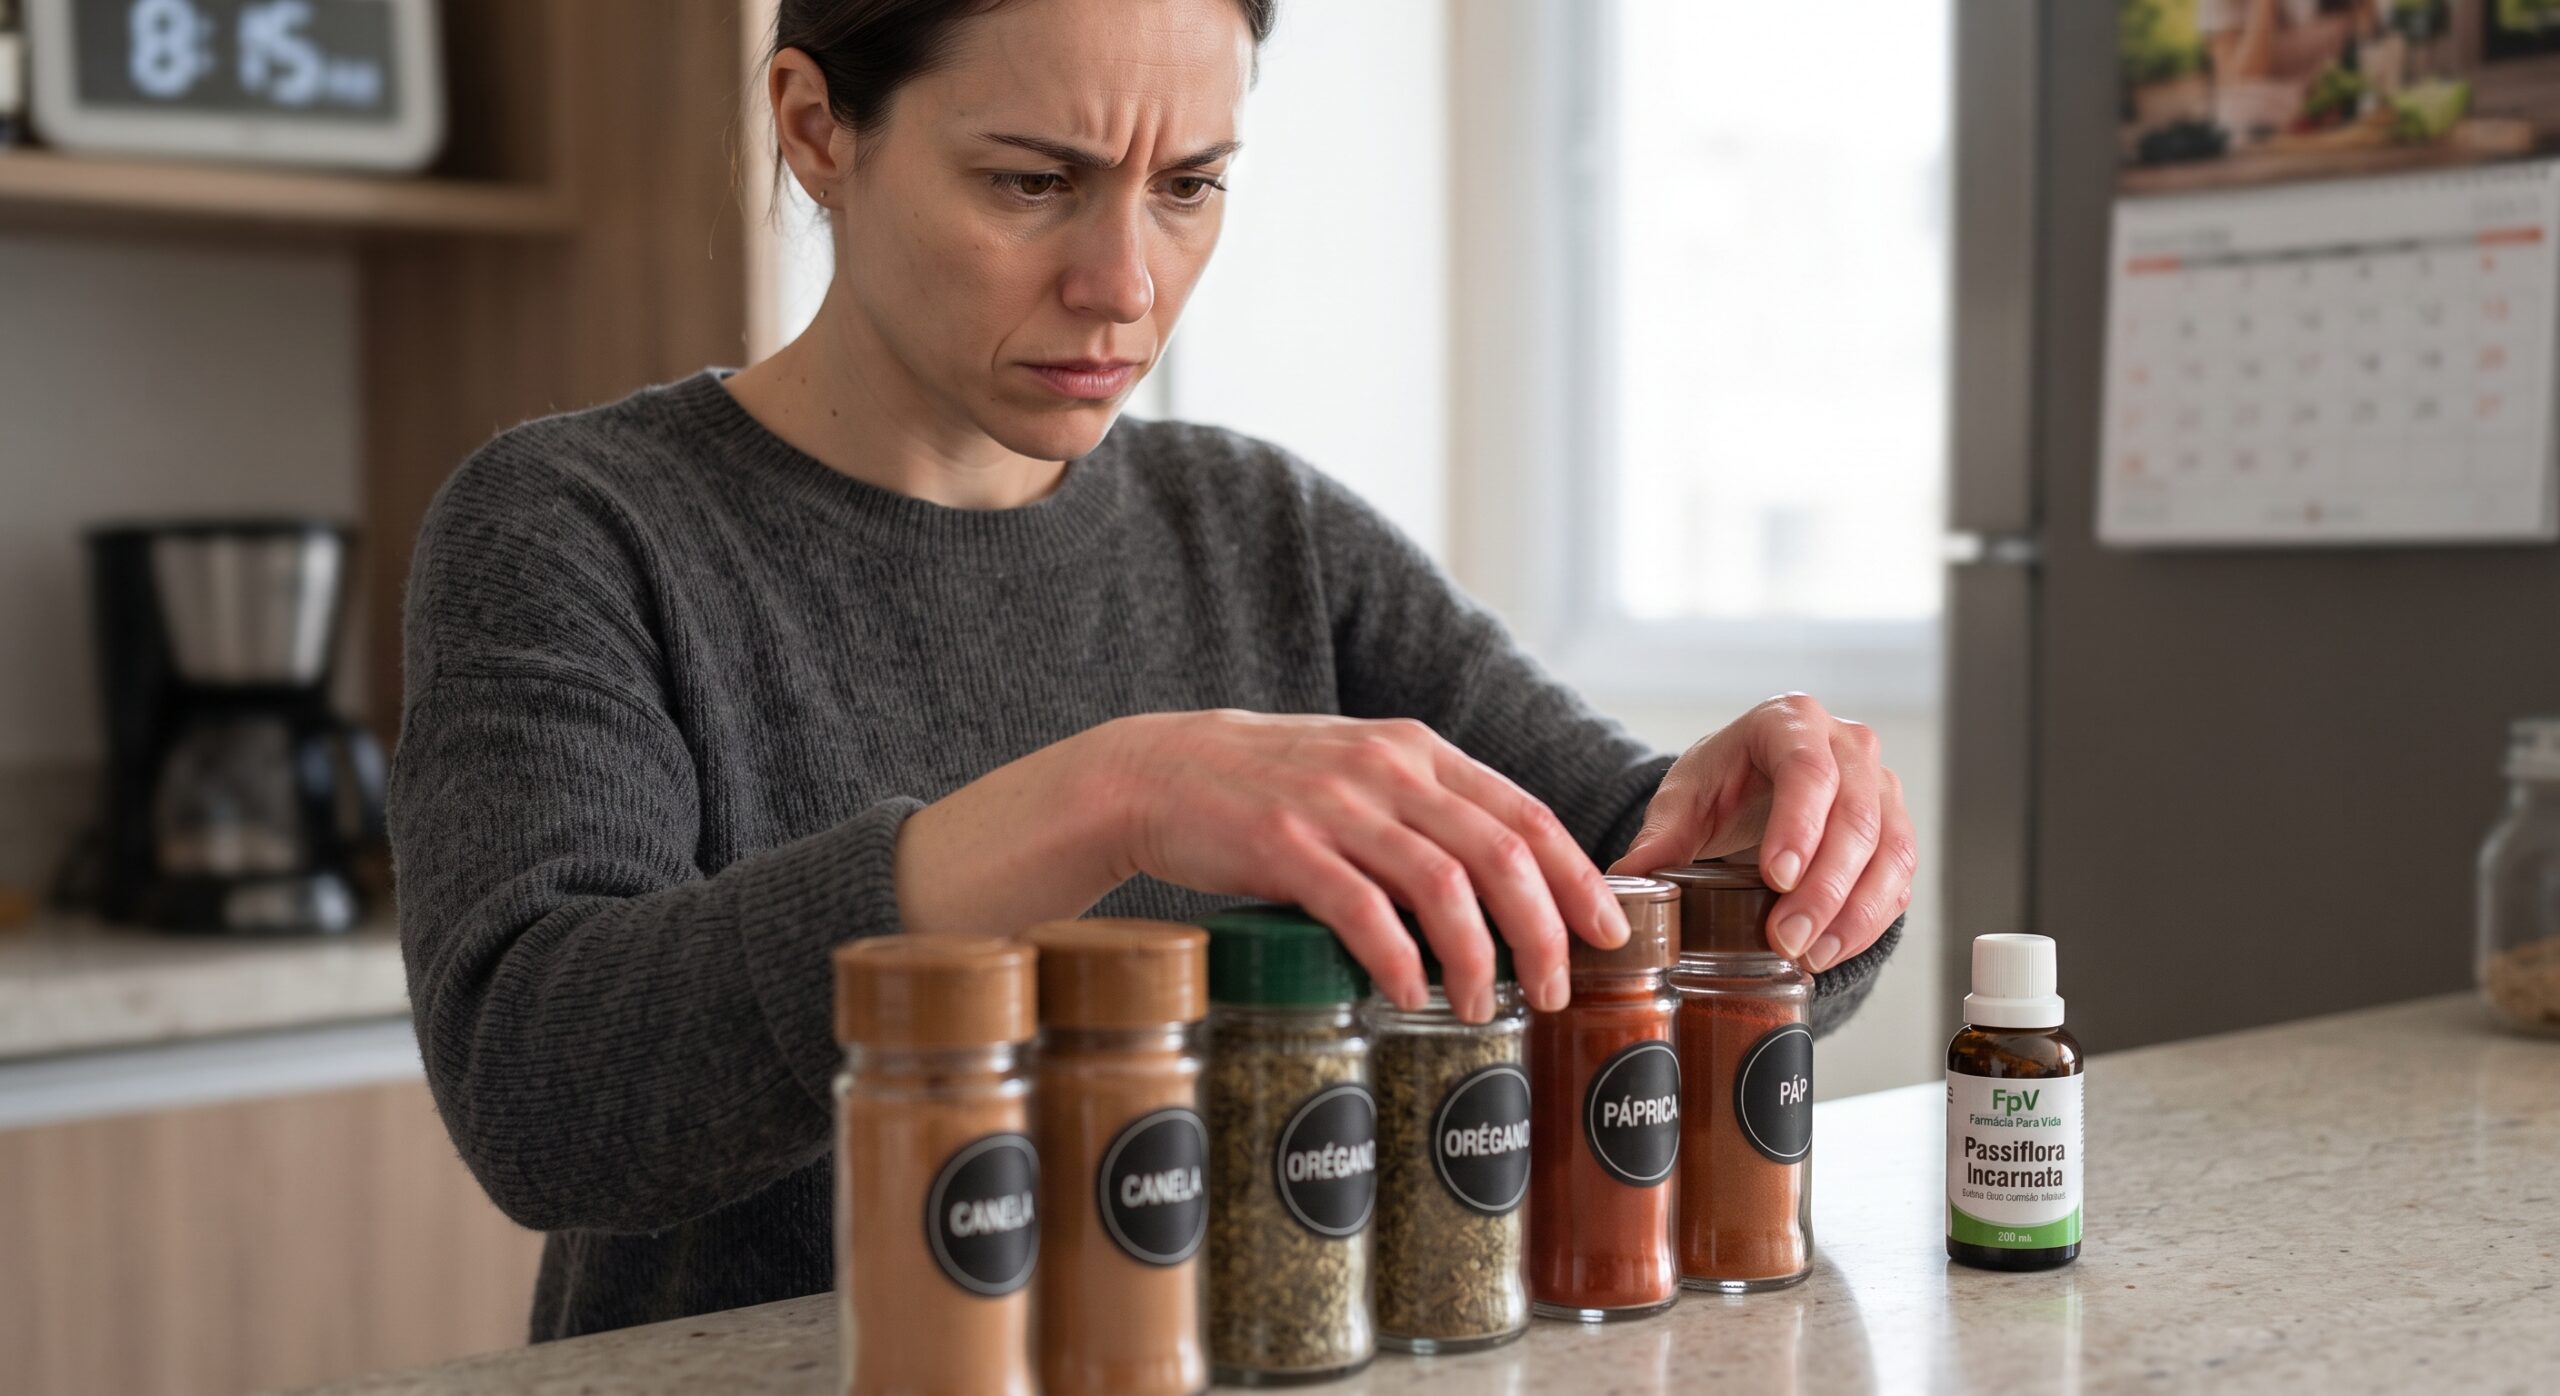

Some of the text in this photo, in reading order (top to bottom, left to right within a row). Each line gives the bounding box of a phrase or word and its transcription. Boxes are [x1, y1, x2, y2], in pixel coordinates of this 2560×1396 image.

[1780, 1074, 1807, 1106] PÁP
[1992, 1088, 2040, 1117] FpV
[1603, 1094, 1678, 1128] PÁPRICA
[2016, 1117, 2040, 1128] Para
[2042, 1116, 2062, 1127] Vida
[1965, 1136, 2066, 1163] Passiflora
[1121, 1165, 1203, 1208] CANELA
[1967, 1162, 2064, 1188] Incarnata
[949, 1190, 1035, 1238] CANELA
[1998, 1231, 2016, 1242] 200
